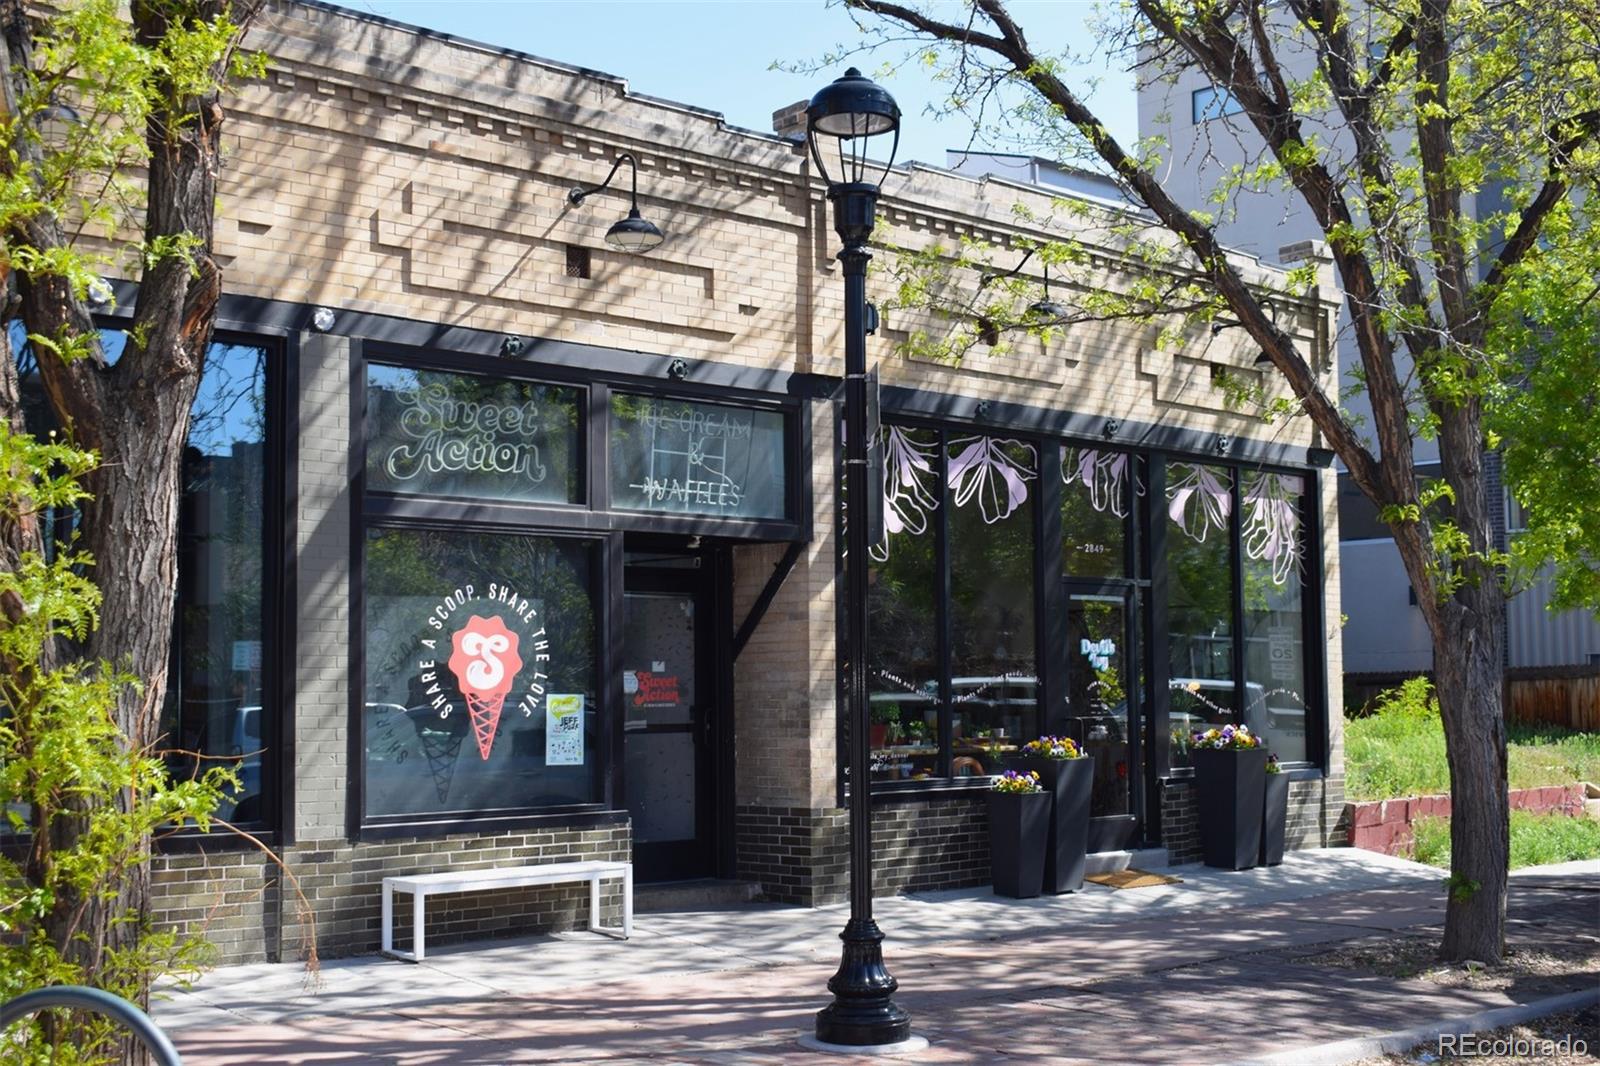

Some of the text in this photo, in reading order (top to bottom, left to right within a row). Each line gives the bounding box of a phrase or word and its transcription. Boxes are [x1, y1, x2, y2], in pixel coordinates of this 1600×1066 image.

[395, 383, 538, 438] Sweet
[679, 408, 752, 440] CREAM
[385, 429, 547, 482] Action
[1083, 543, 1104, 553] 2849
[488, 583, 537, 624] SHARE
[421, 638, 437, 650] A
[532, 627, 550, 662] THE
[420, 660, 453, 720] SHARE
[518, 672, 548, 718] LOVE
[881, 669, 902, 684] Plants
